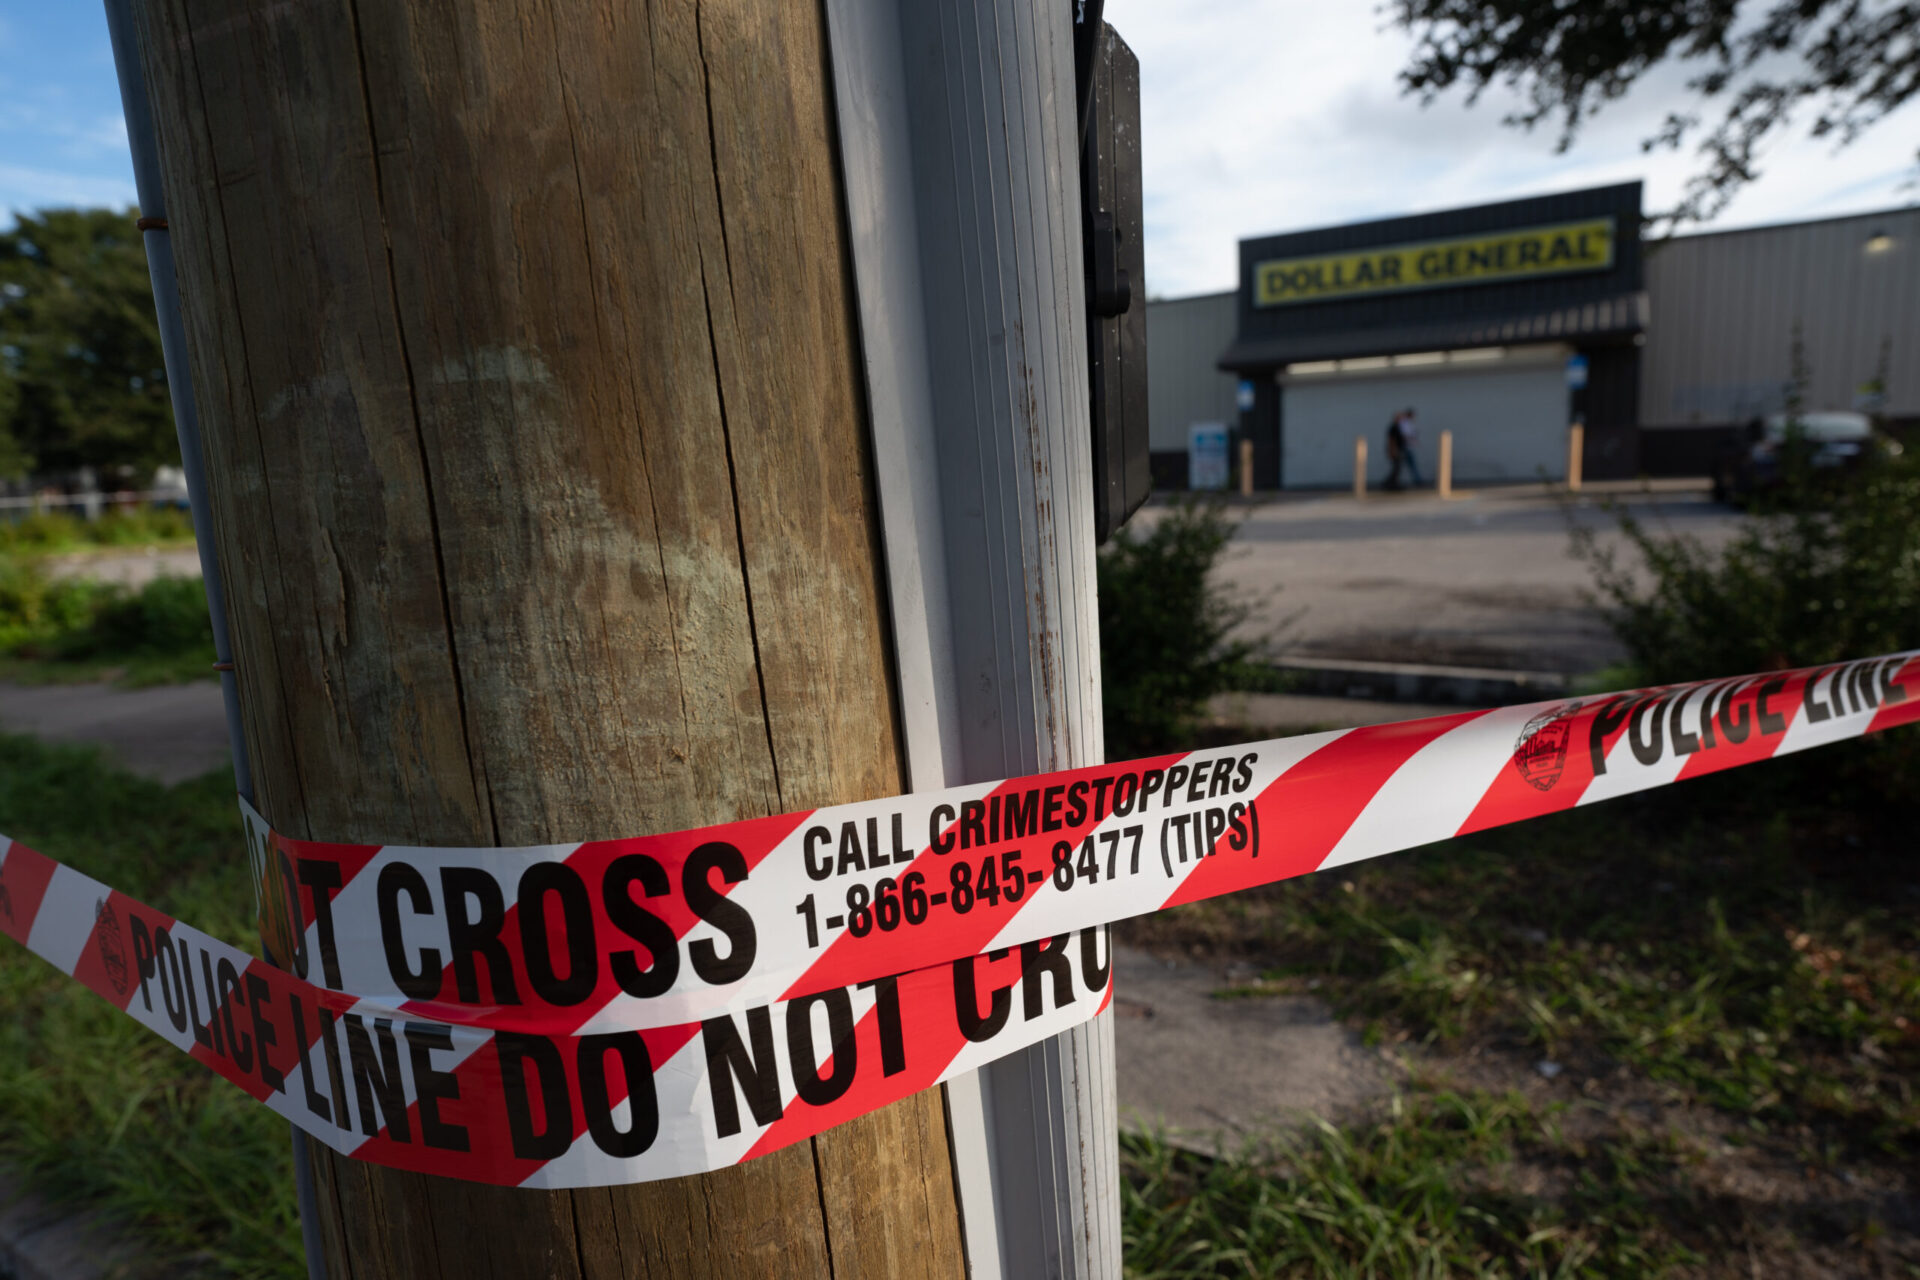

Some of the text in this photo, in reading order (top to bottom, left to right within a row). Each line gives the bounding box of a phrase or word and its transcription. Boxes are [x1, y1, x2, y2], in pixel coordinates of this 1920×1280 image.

[1266, 232, 1598, 297] DOLLAR GENERAL
[1590, 656, 1910, 777] POLICE LINE
[802, 752, 1259, 882] CALL CRIMESTOPPERS
[1159, 800, 1260, 878] (TIPS)
[377, 841, 758, 1007] CROSS
[129, 913, 287, 1095] POLICE
[290, 993, 472, 1153] LINE
[495, 1029, 660, 1159] DO
[702, 972, 907, 1139] NOT
